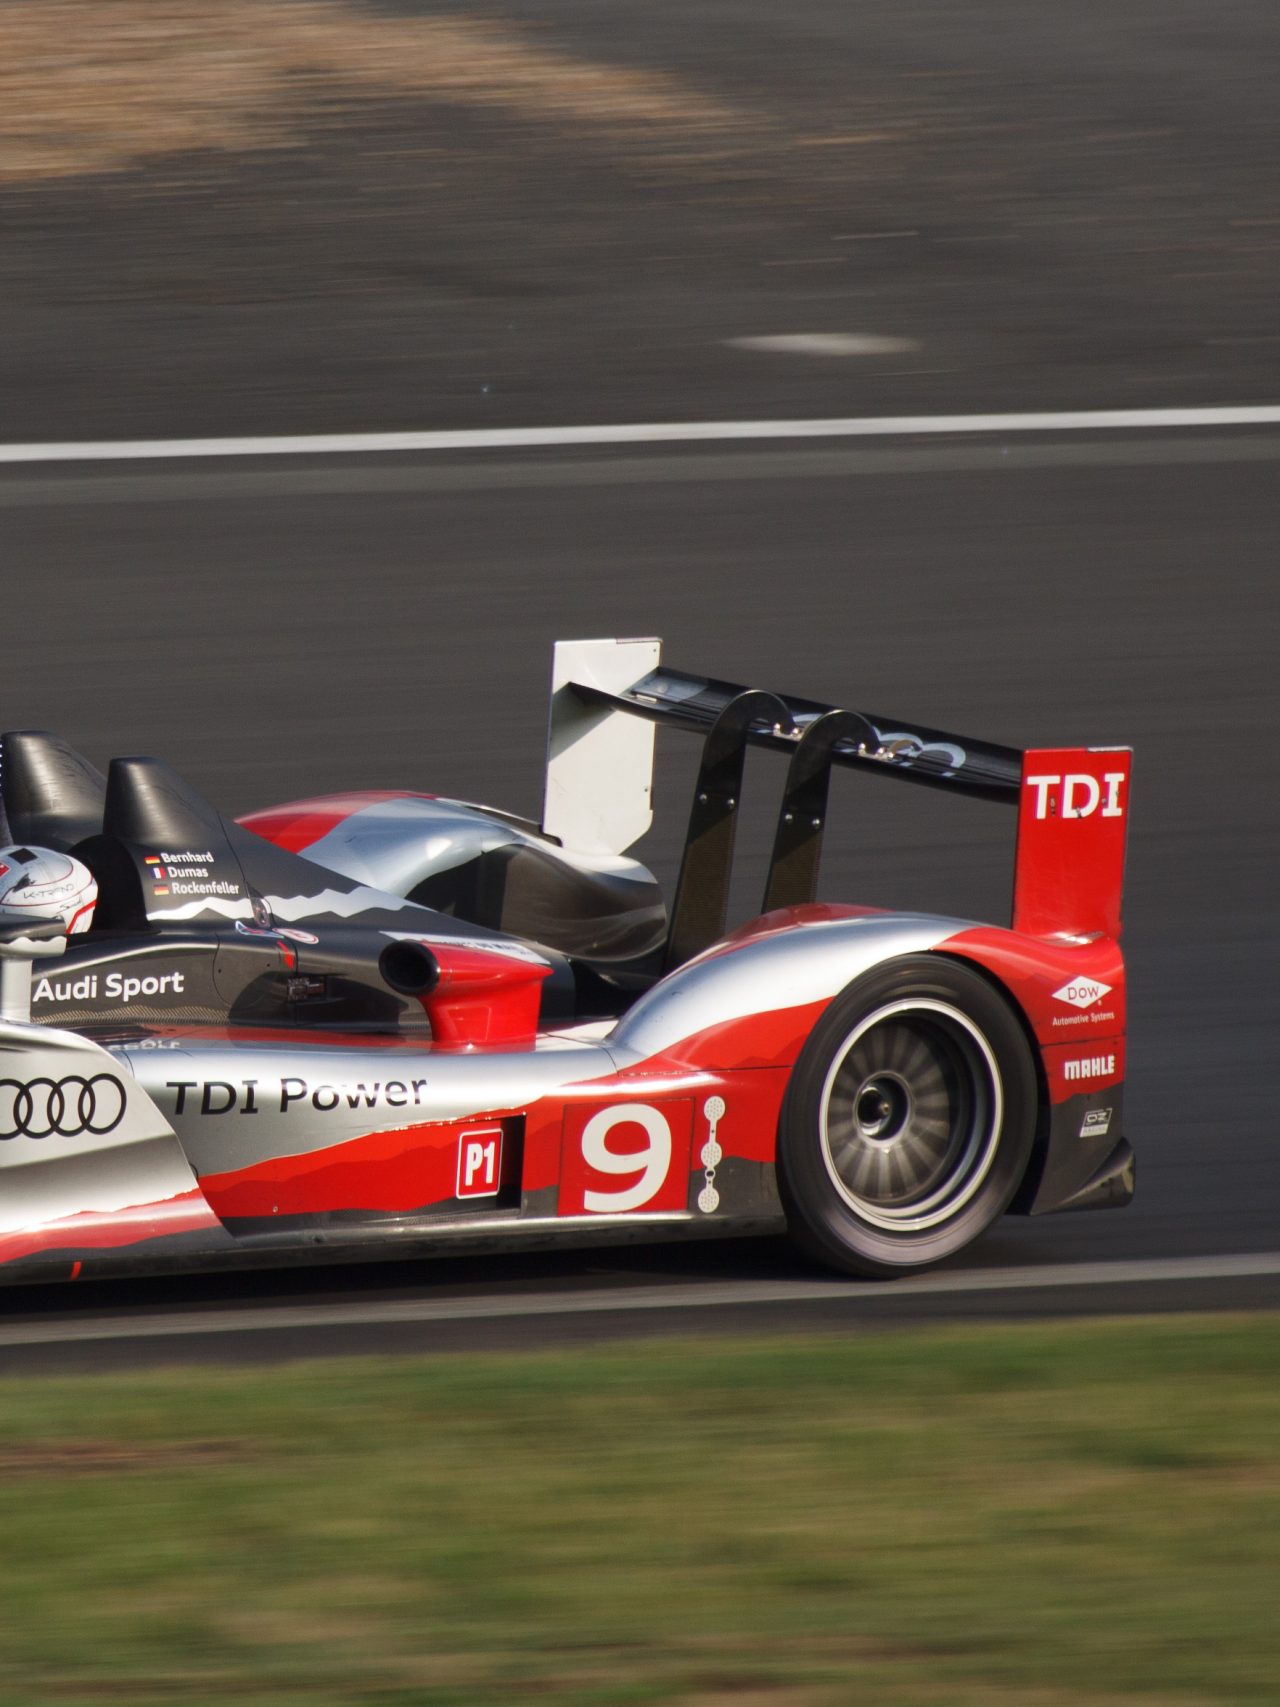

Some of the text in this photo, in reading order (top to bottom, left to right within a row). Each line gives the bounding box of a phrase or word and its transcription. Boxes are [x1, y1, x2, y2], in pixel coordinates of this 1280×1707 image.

[1027, 773, 1125, 819] TDI
[160, 851, 215, 863] Bernhard
[167, 867, 209, 878] Dumas
[172, 881, 240, 895] Rockenfeller
[32, 971, 185, 1002] Audi Sport
[1052, 1010, 1115, 1027] Automotive Systems
[1064, 1055, 1115, 1081] MAHLE
[166, 1077, 427, 1116] TDI Power
[464, 1141, 496, 1187] P1
[581, 1103, 672, 1213] 9
